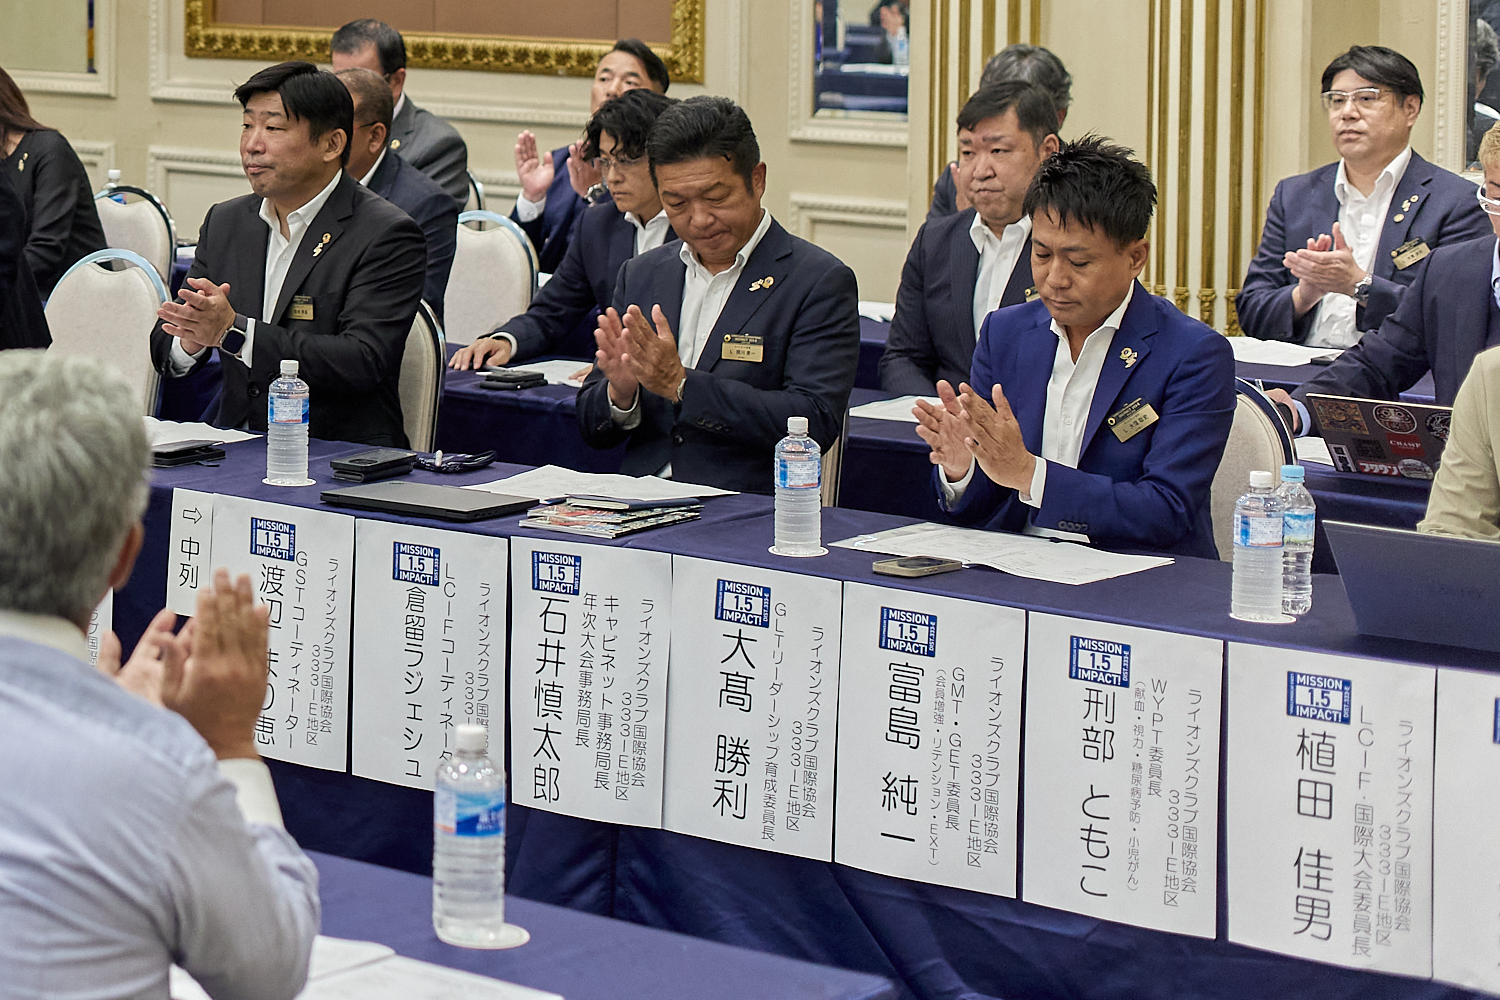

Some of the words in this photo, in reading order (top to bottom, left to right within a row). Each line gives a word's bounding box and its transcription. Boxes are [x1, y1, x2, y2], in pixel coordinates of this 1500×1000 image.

[178, 536, 200, 590] 中列
[256, 520, 290, 533] MISSION
[256, 546, 289, 560] IMPACT!
[265, 531, 281, 548] 1.5
[399, 544, 434, 558] MISSION
[408, 555, 425, 572] 1.5
[539, 552, 575, 566] MISSION
[399, 571, 434, 585] IMPACT!
[539, 580, 574, 595] IMPACT!
[548, 564, 566, 581] 1.5
[724, 581, 764, 597] MISSION
[734, 594, 754, 613] 1.5
[285, 550, 308, 749] GSTコーディネーター
[320, 557, 339, 735] ライオンズクラブ国際協会
[723, 609, 763, 626] IMPACT!
[887, 638, 928, 656] IMPACT!
[888, 609, 930, 626] MISSION
[898, 623, 919, 641] 1.5
[1078, 638, 1123, 655] MISSION
[307, 644, 321, 746] 333-E地区
[575, 592, 598, 748] 年次大会事務局長
[593, 595, 620, 791] キャビネット事務局長
[631, 598, 655, 788] ライオンズクラブ国際協会
[1077, 668, 1122, 686] IMPACT!
[1089, 652, 1111, 671] 1.5
[1296, 673, 1343, 691] MISSION
[1308, 687, 1331, 708] 1.5
[760, 602, 787, 842] GLTリーダーシップ育成委員長
[802, 626, 825, 819] ライオンズクラブ国際協会
[884, 661, 925, 750] 富島
[1081, 687, 1116, 764] 刑部
[1147, 677, 1168, 798] WYPT委員長
[1296, 705, 1342, 723] IMPACT!
[615, 691, 632, 800] 333-E地区
[712, 733, 751, 820] 勝利
[786, 720, 803, 832] 333-E地区
[945, 666, 966, 831] GMT・GET委員長
[984, 656, 1005, 855] ライオンズクラブ国際協会
[1295, 727, 1337, 820] 植田
[880, 770, 919, 843] 純一
[966, 754, 984, 868] 333-E地区
[1181, 688, 1203, 894] ライオンズクラブ国際協会
[1394, 720, 1414, 933] ライオンズクラブ国際協会
[1079, 783, 1111, 898] ともこ
[1163, 788, 1181, 907] 333-E地区
[1351, 705, 1375, 959] LCIF・国際大会委員長
[1292, 845, 1335, 942] 佳男
